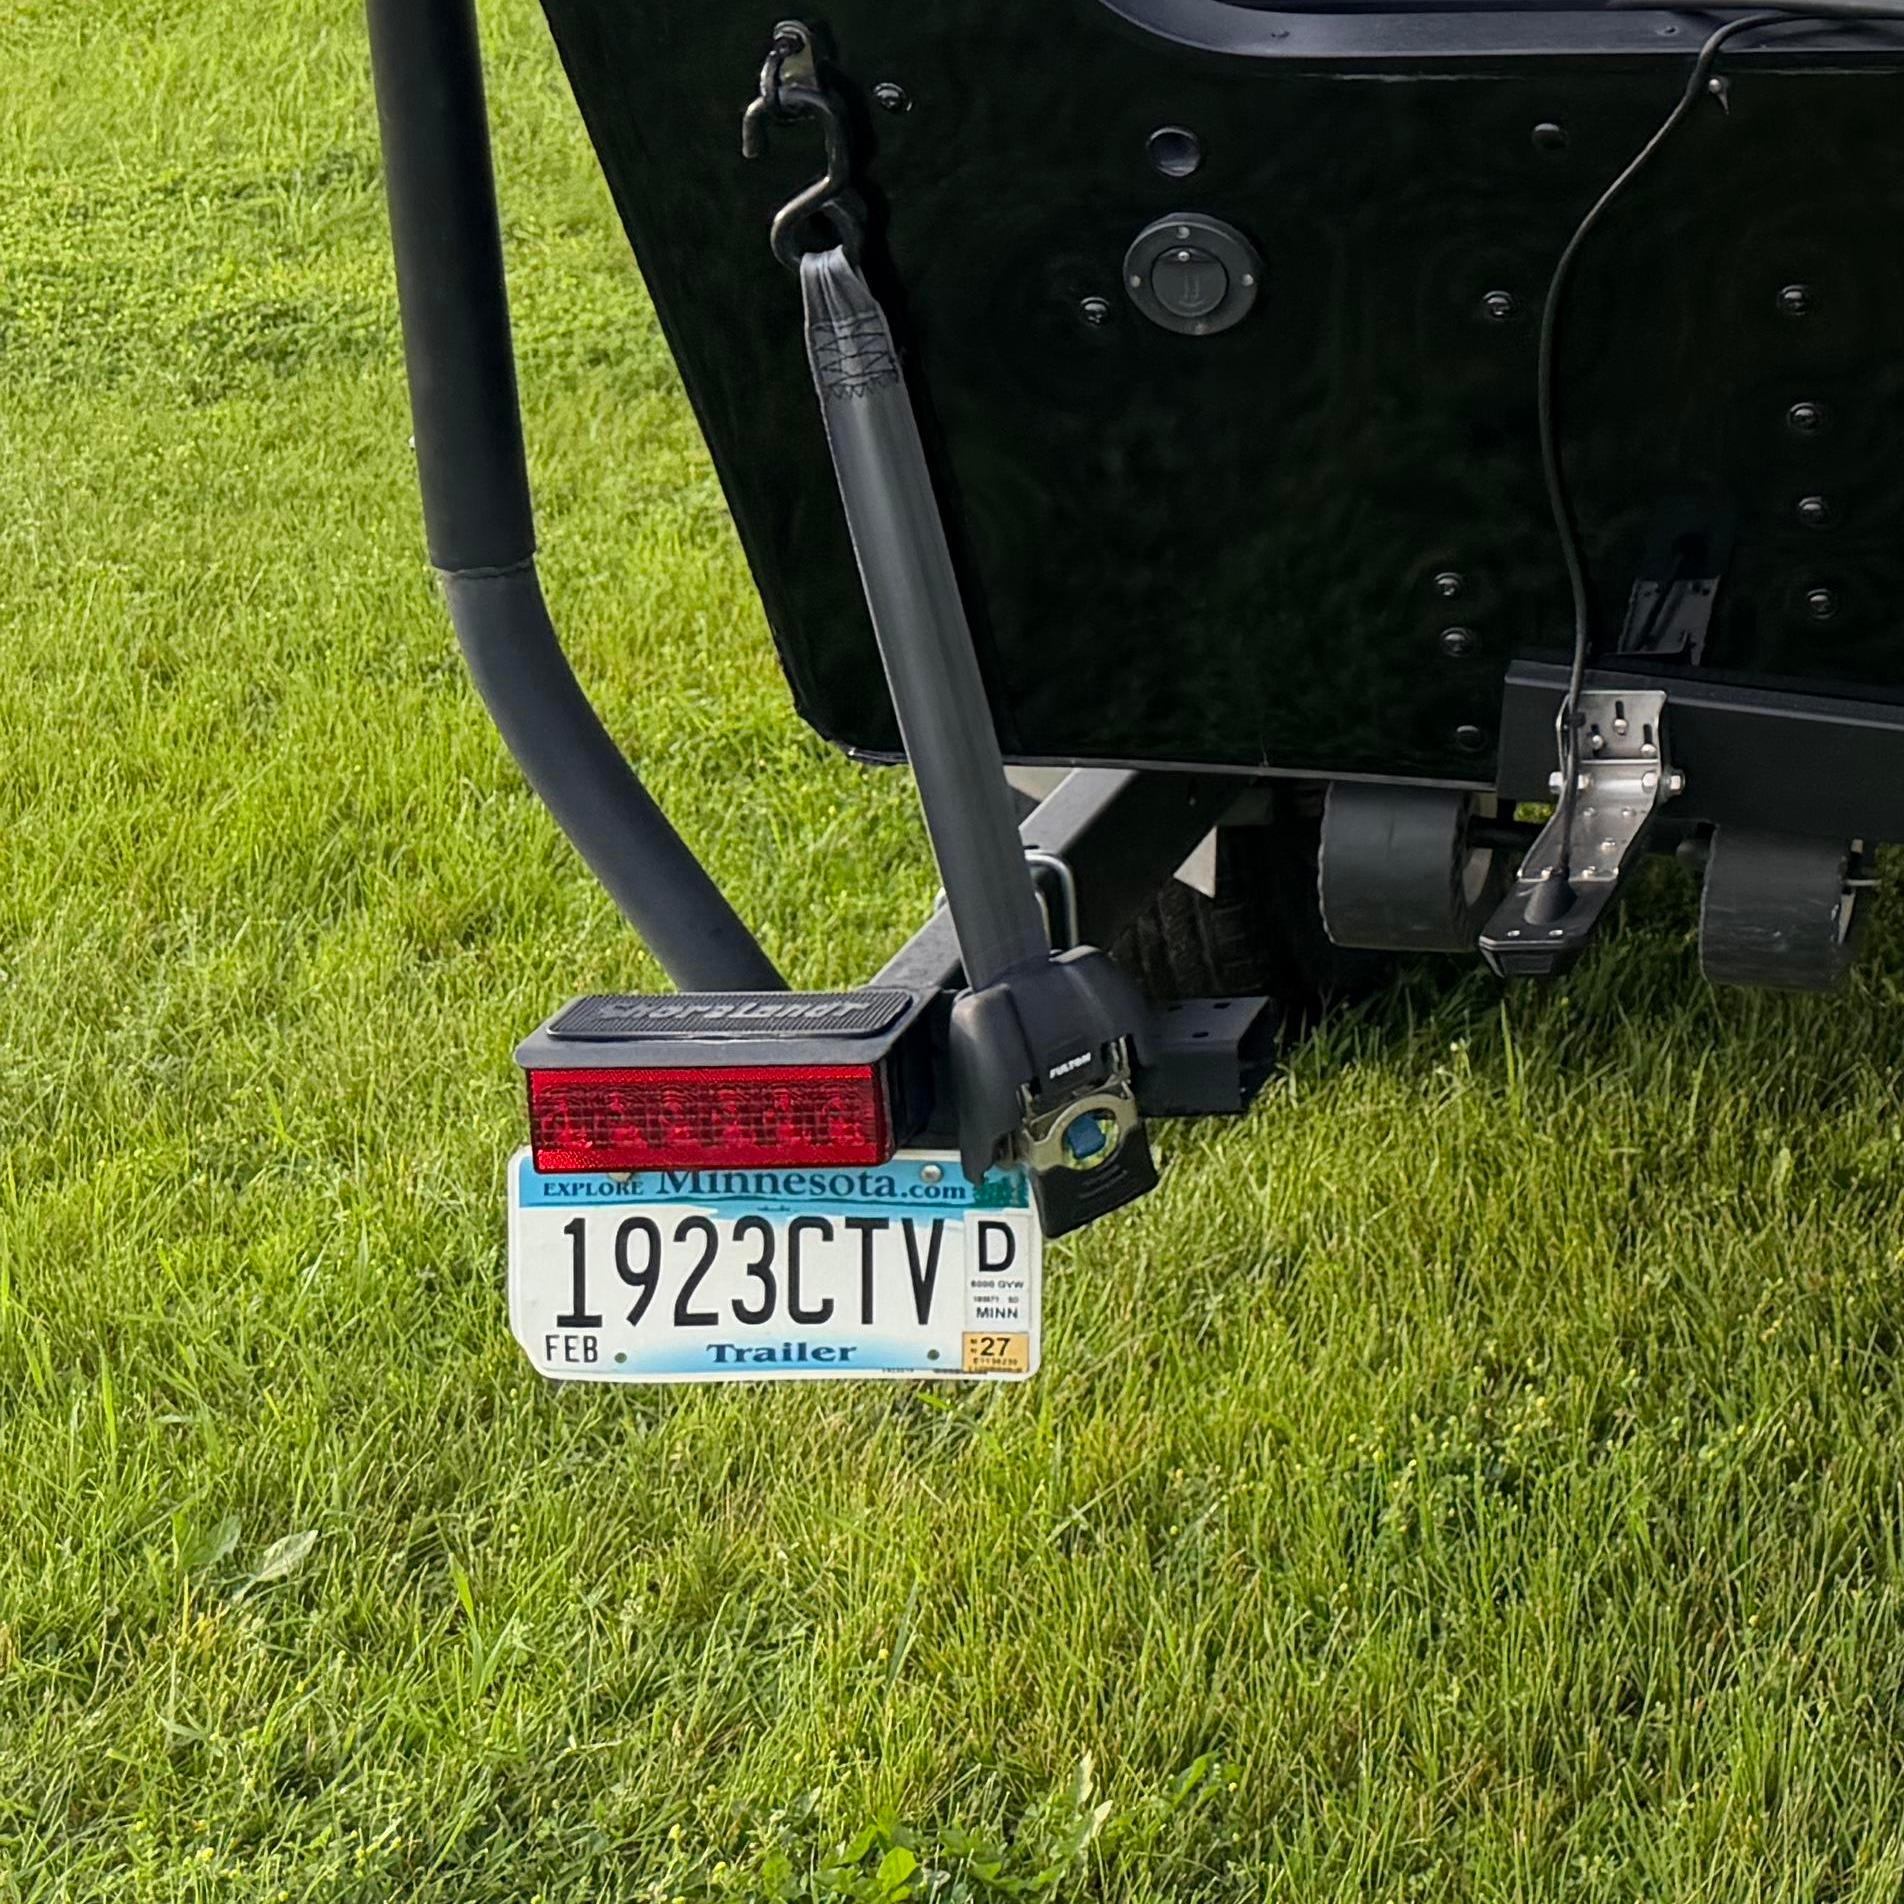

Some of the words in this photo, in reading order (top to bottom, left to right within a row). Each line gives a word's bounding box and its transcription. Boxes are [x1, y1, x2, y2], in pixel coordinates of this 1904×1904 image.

[543, 1181, 645, 1197] EXPLORE
[977, 1220, 1017, 1273] D
[556, 1213, 945, 1328] 1923CTV
[976, 1306, 1019, 1319] MINN
[544, 1333, 599, 1364] FEB
[706, 1342, 858, 1364] Trailer
[980, 1336, 1011, 1357] 27
